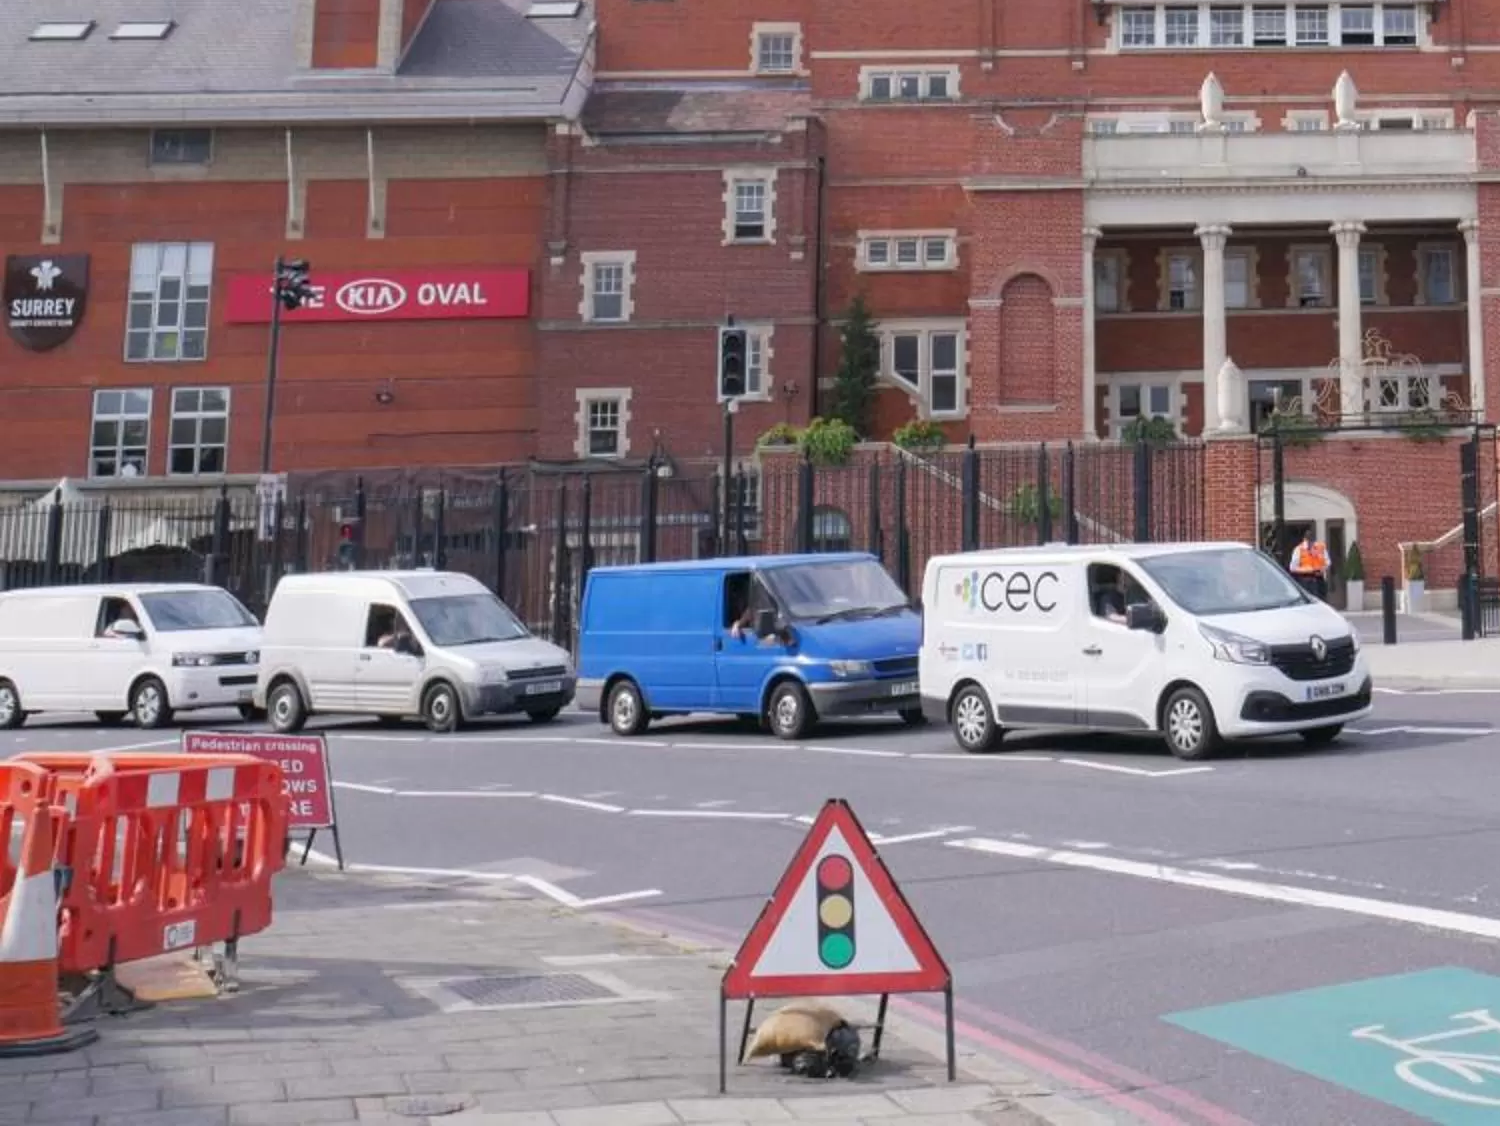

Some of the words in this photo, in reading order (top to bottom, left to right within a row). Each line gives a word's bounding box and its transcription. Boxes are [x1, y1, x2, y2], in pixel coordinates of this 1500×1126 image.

[416, 282, 488, 305] OVAL
[11, 298, 75, 317] SURREY
[980, 571, 1059, 612] cec
[191, 737, 261, 751] Pedestrian
[264, 741, 317, 754] crossing
[280, 759, 304, 773] ED
